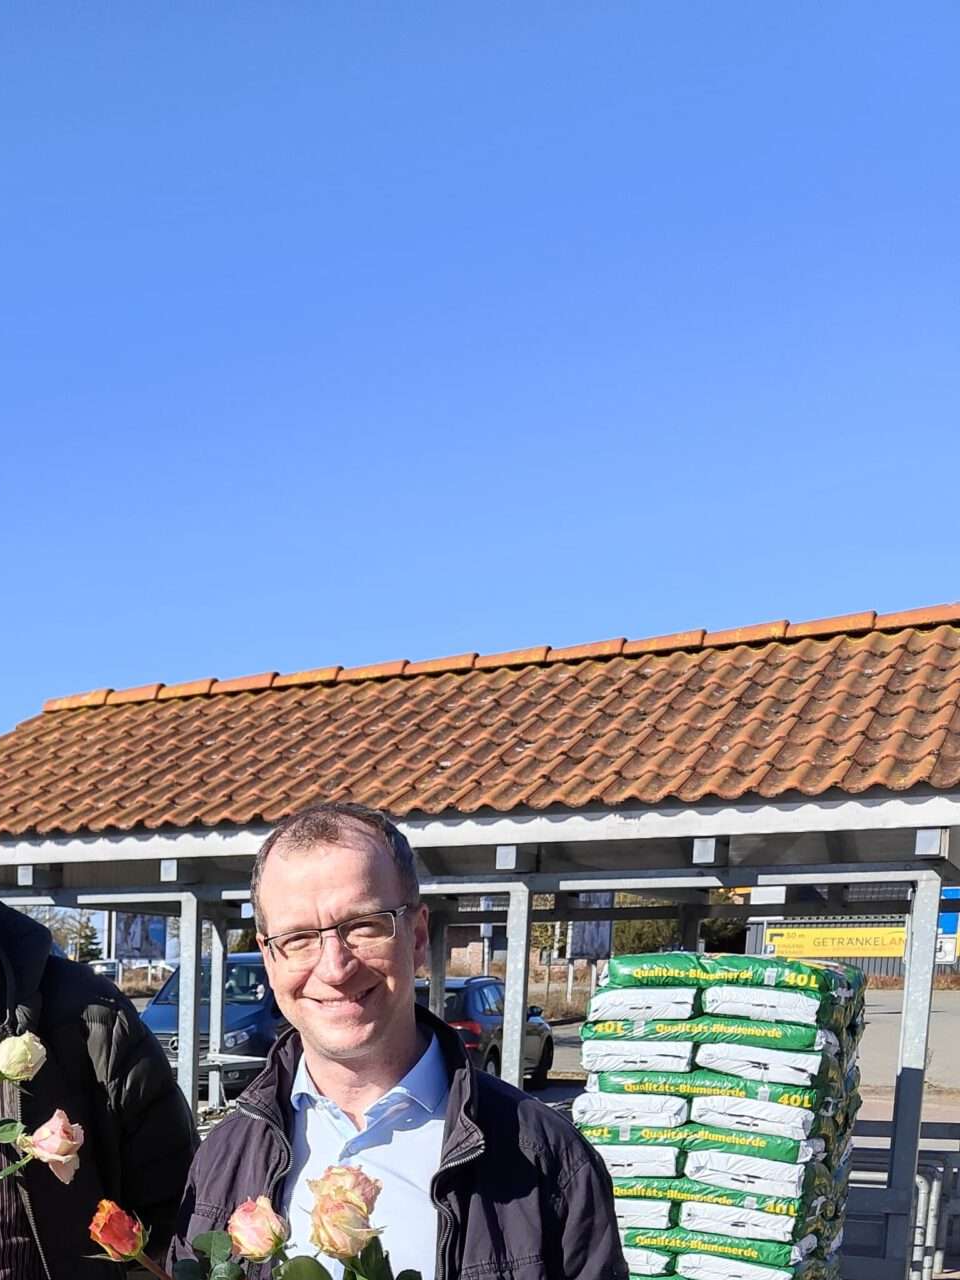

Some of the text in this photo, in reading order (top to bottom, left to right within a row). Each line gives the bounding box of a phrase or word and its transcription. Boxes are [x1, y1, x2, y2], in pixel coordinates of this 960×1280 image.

[813, 936, 906, 947] GETRÄNKELAN
[632, 967, 753, 981] Qualitäts-Blumenerde
[655, 1022, 782, 1038] Qualitäts-Blumenerde
[623, 1082, 746, 1098] Qualitäts-Blumenerde
[636, 1236, 759, 1258] Qualitäts-Blumenerde
